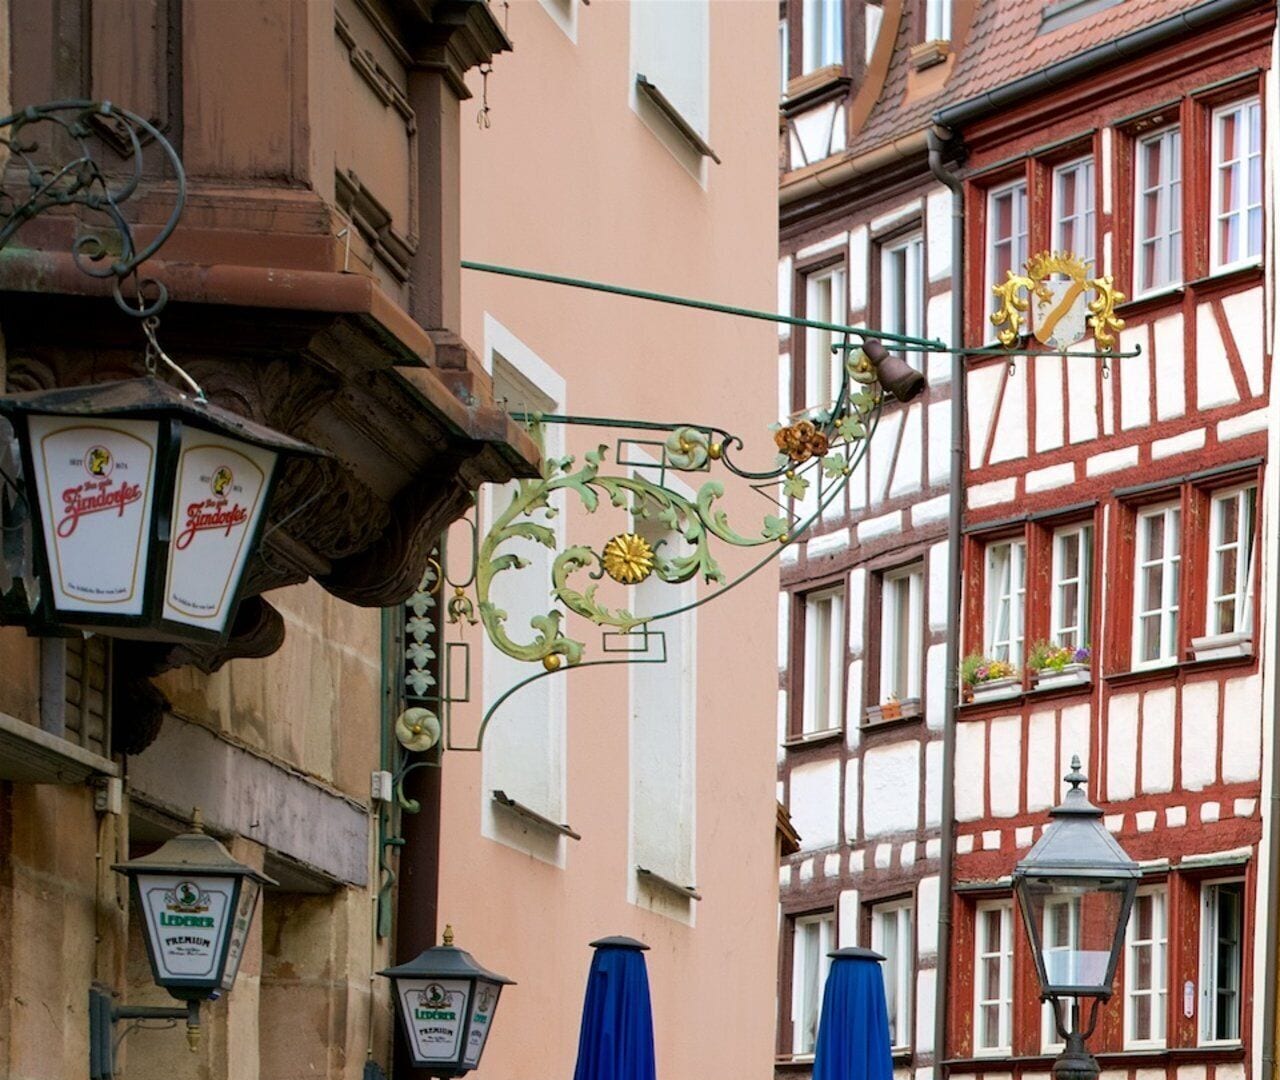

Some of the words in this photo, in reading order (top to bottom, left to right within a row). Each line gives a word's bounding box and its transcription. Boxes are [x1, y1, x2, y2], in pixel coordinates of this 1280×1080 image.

[57, 480, 142, 538] Zirndorfer
[159, 912, 215, 929] LEDERER
[165, 935, 211, 948] PREMIUM
[414, 1008, 457, 1021] LEDERER
[419, 1027, 454, 1037] PREMIUM
